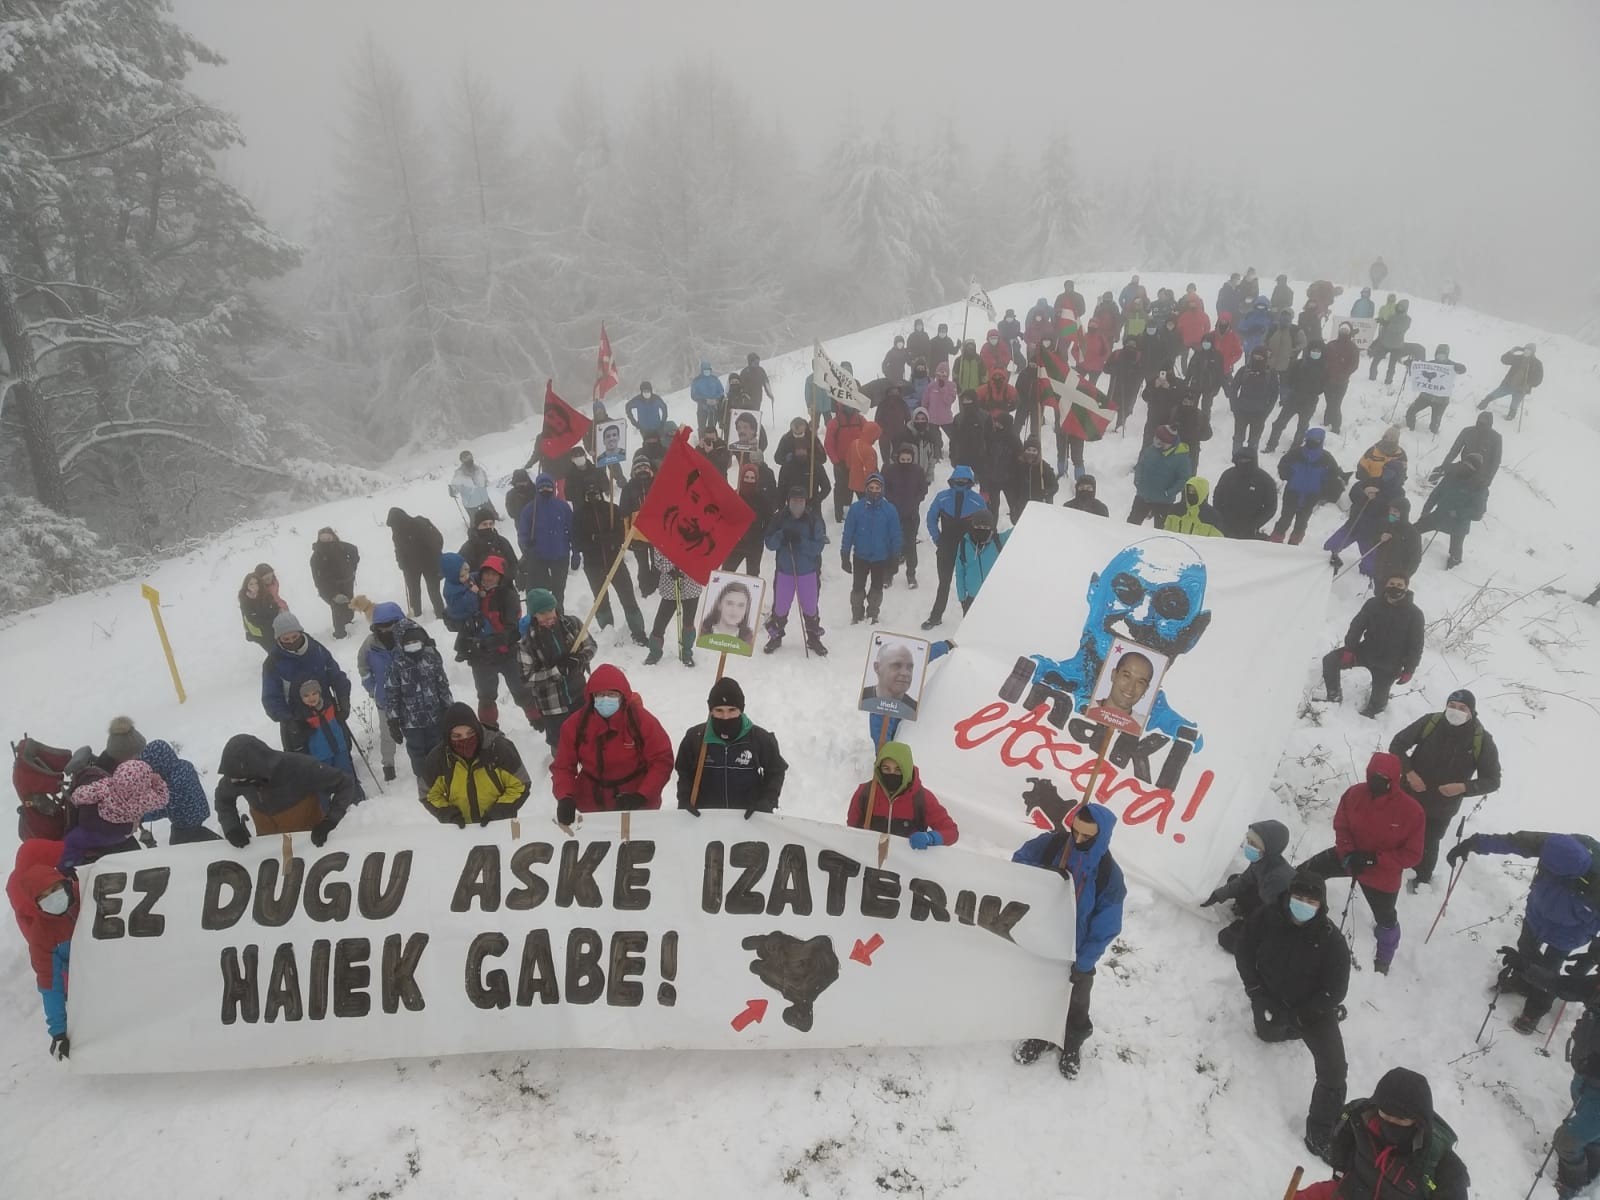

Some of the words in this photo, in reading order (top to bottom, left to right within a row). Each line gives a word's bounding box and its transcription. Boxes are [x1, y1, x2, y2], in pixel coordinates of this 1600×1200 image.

[92, 866, 170, 940] EZ
[201, 849, 413, 931] DUGU
[450, 840, 656, 913] ASKE
[701, 840, 1031, 945] IZATERIK
[220, 932, 430, 1025] HAIEK
[465, 927, 679, 1010] GABE!
